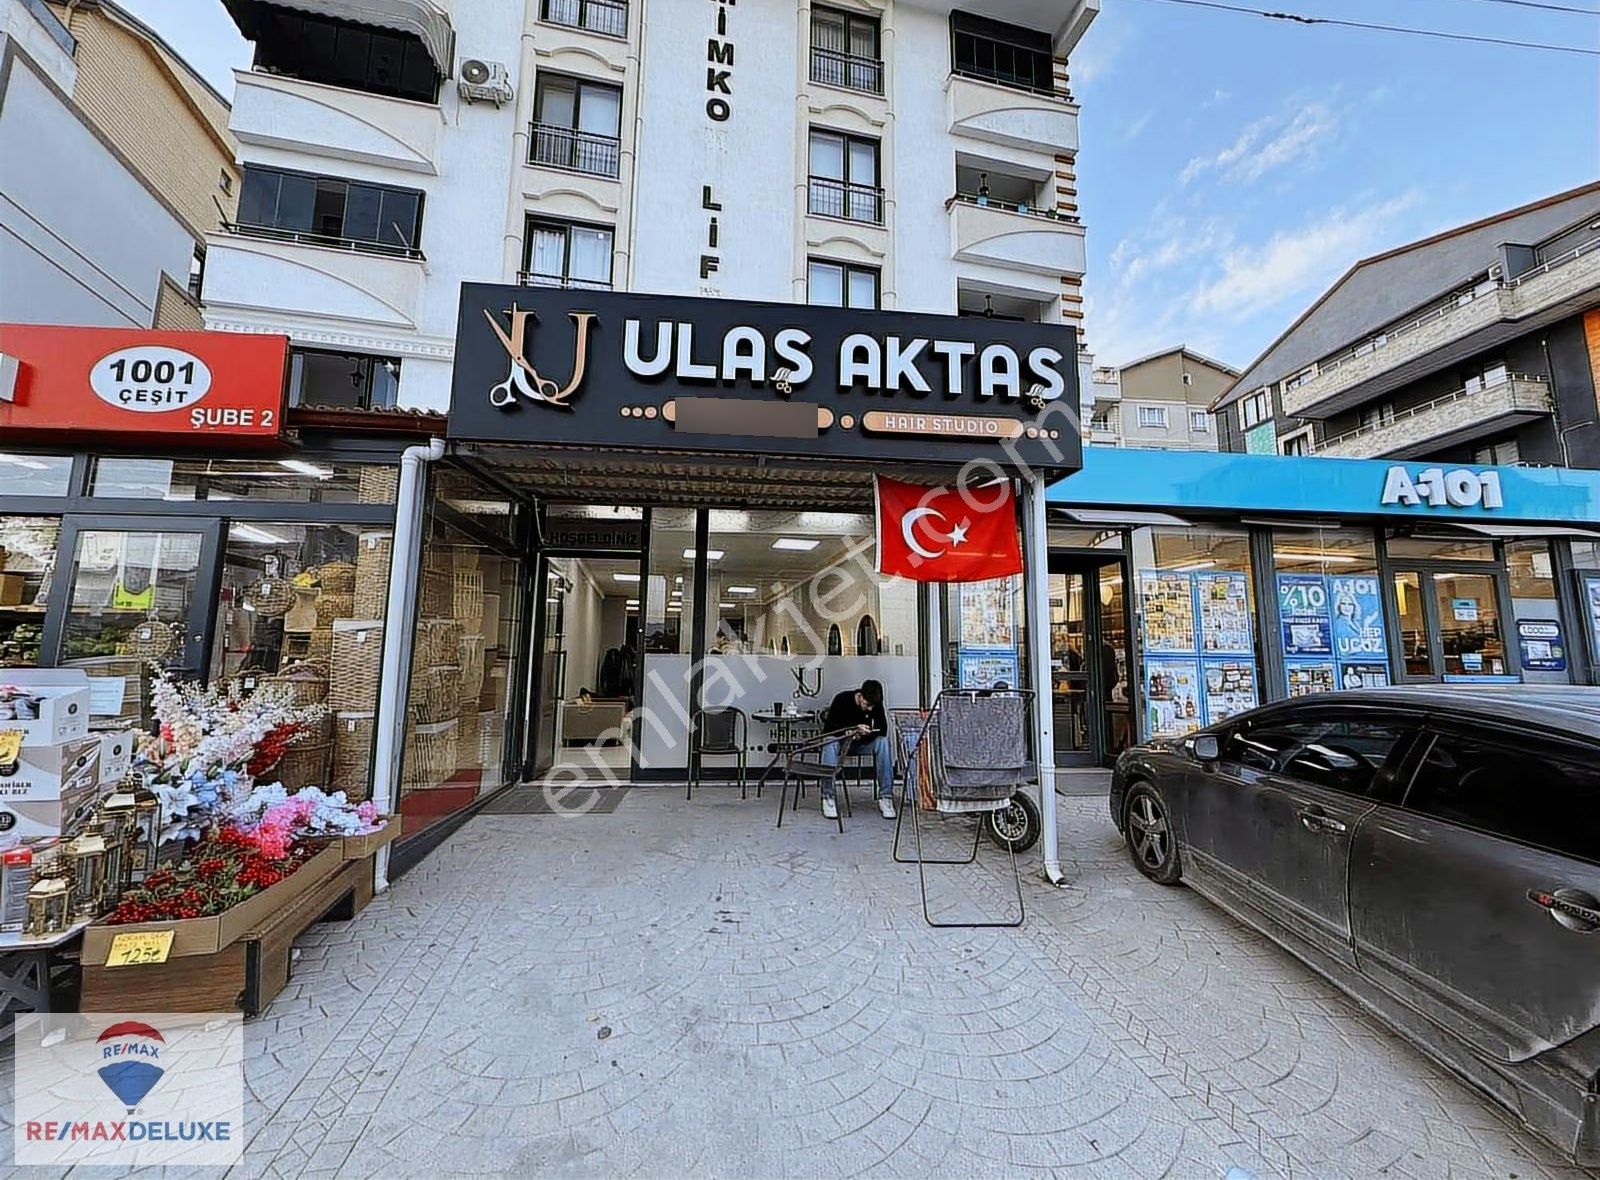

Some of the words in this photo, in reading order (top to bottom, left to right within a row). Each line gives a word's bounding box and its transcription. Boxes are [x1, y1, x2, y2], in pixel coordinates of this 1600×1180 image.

[109, 358, 195, 385] 1001
[623, 319, 814, 395] ULAŞ
[839, 333, 1065, 409] AKTAŞ
[118, 387, 189, 406] ÇEŞİT
[190, 408, 255, 429] ŞUBE
[260, 410, 273, 427] 2
[884, 415, 926, 431] HAIR
[932, 417, 999, 434] STUDIO
[1280, 585, 1326, 607] %10
